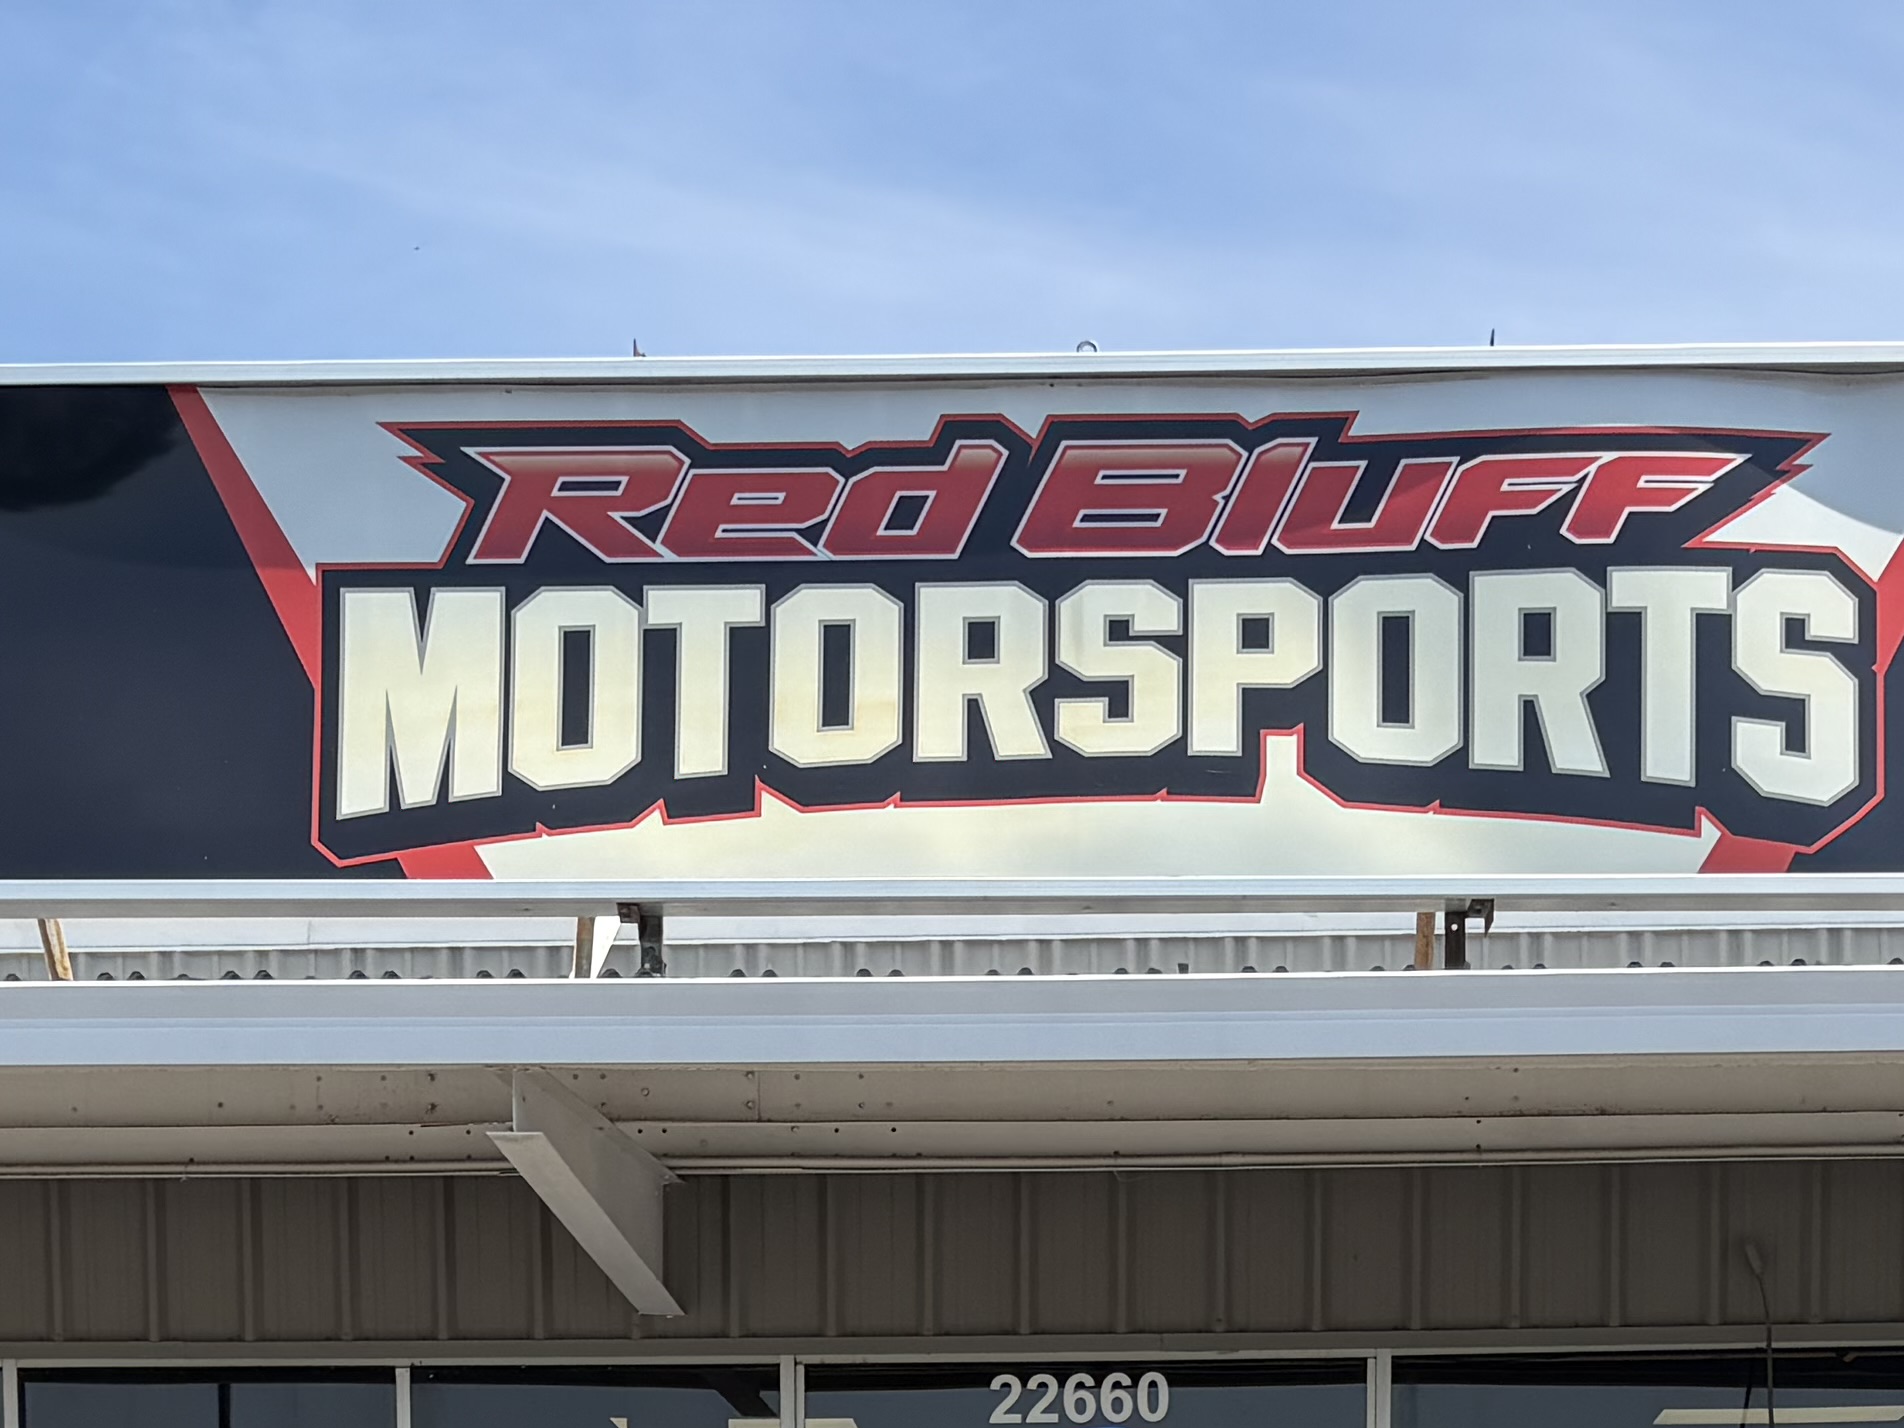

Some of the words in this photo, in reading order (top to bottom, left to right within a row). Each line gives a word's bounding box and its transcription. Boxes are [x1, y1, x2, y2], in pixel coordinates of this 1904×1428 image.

[460, 445, 1008, 565] Red
[336, 565, 1859, 821] MOTORSPORTS
[989, 1371, 1169, 1424] 22660
